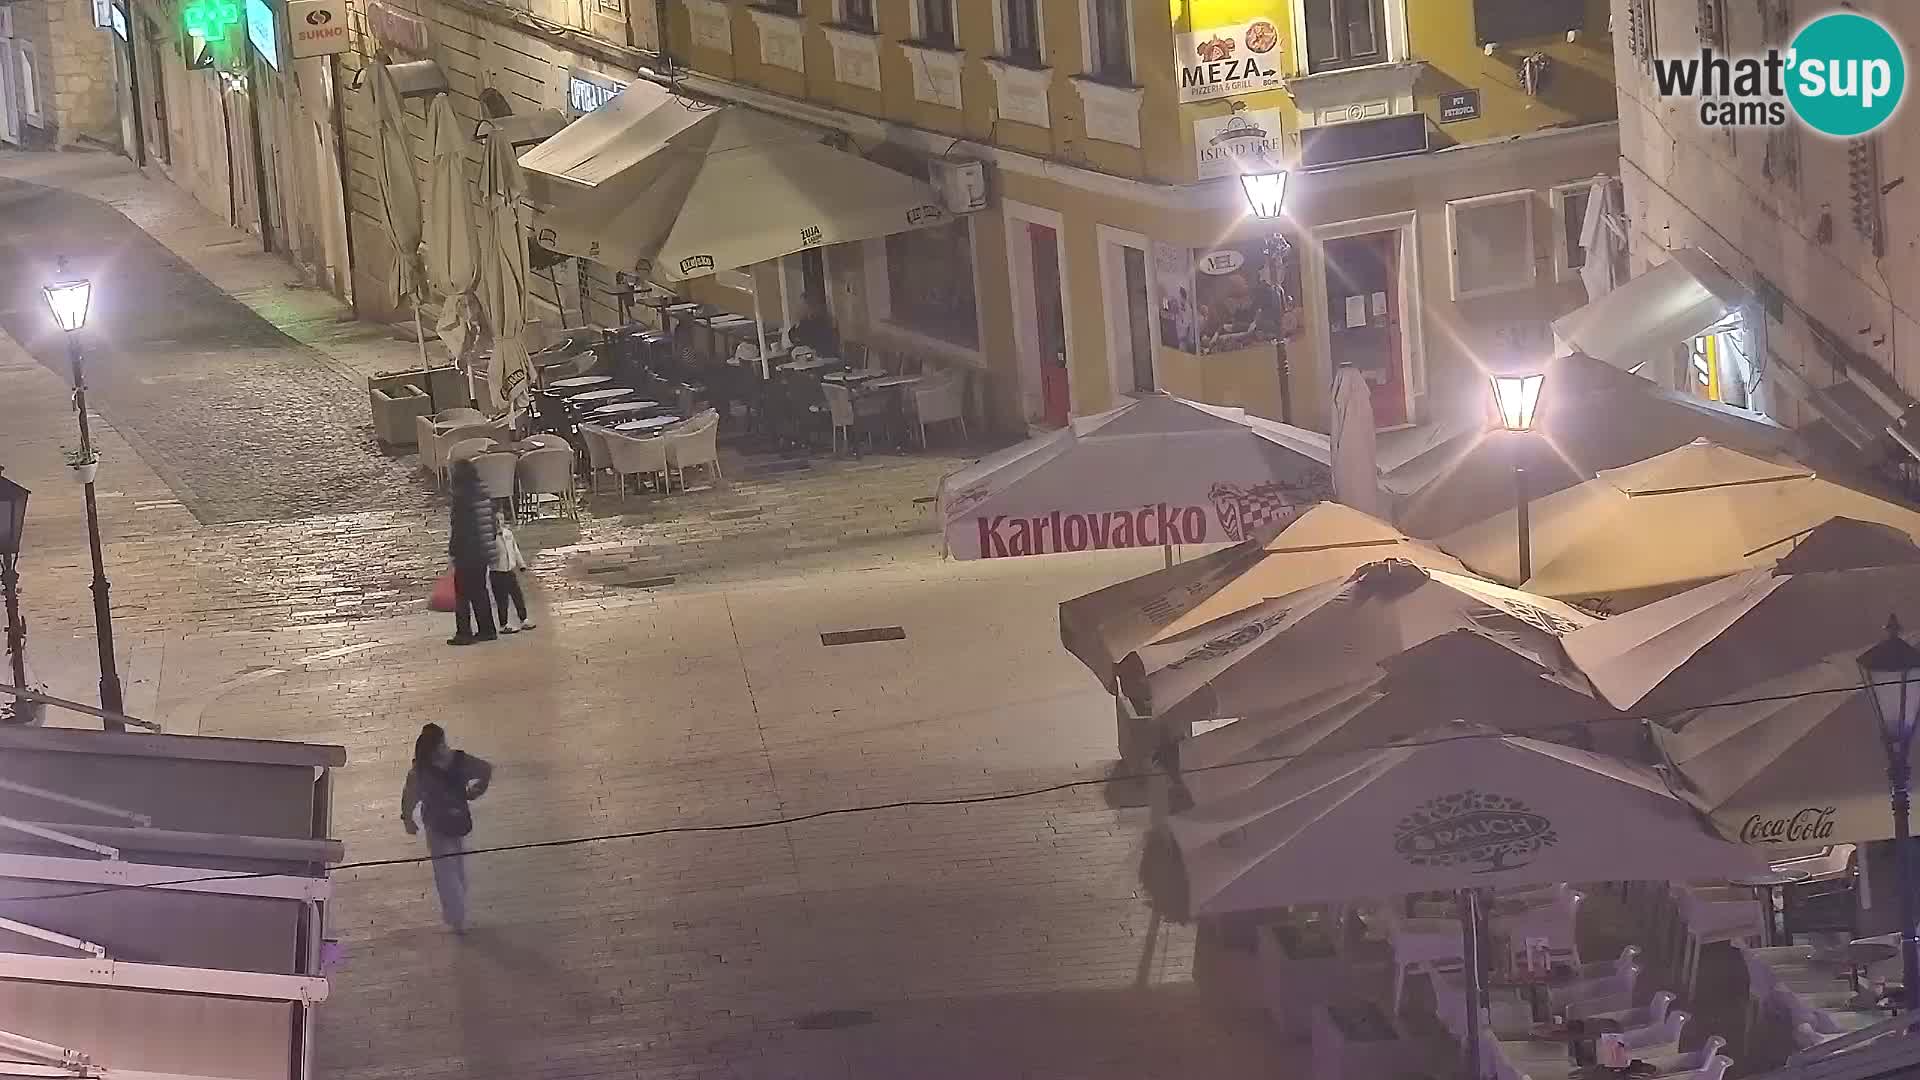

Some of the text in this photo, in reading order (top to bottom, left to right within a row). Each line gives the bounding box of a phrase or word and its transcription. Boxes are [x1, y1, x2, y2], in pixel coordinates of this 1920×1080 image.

[298, 27, 343, 41] SUKNO
[1182, 57, 1261, 88] MEZA
[1191, 79, 1253, 96] PIZZERIA & GRILL
[976, 502, 1208, 559] Karlovačko
[1434, 818, 1534, 849] RAUCH
[1740, 806, 1837, 845] Coca-Cola
